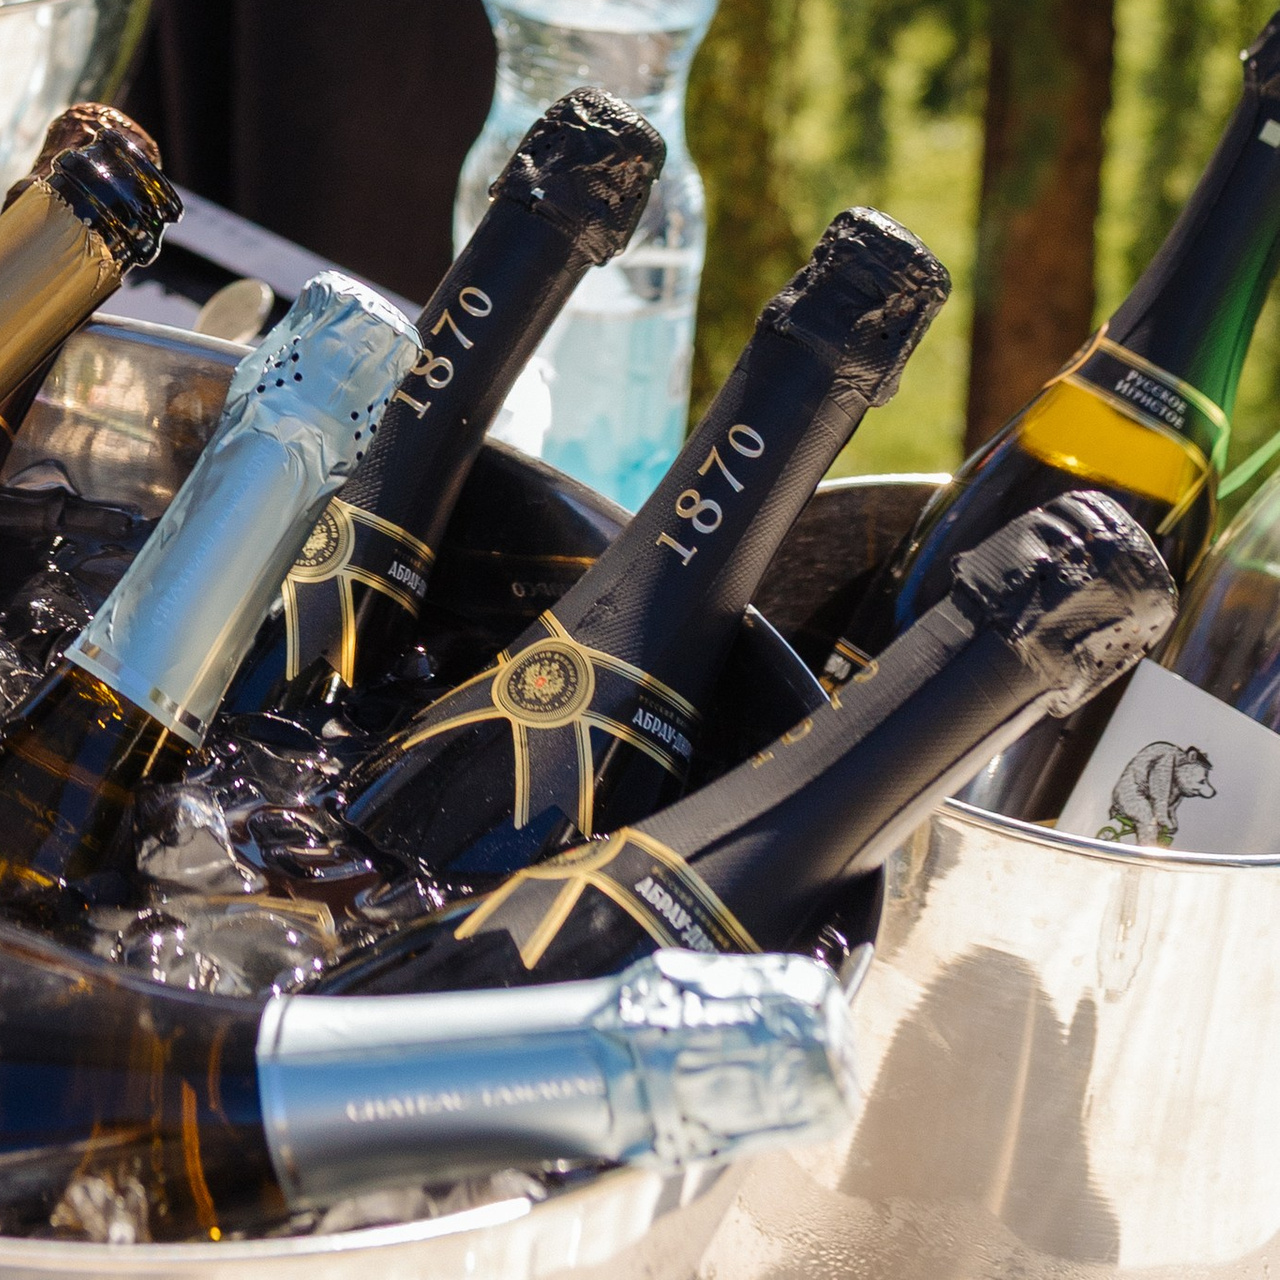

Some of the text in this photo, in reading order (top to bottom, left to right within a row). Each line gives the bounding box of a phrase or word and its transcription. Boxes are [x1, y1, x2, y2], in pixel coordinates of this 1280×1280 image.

[391, 286, 492, 419] 1870
[1126, 369, 1188, 414] РУССКОЕ
[1115, 379, 1185, 430] ИГРИСТОЕ
[655, 424, 765, 566] 1870
